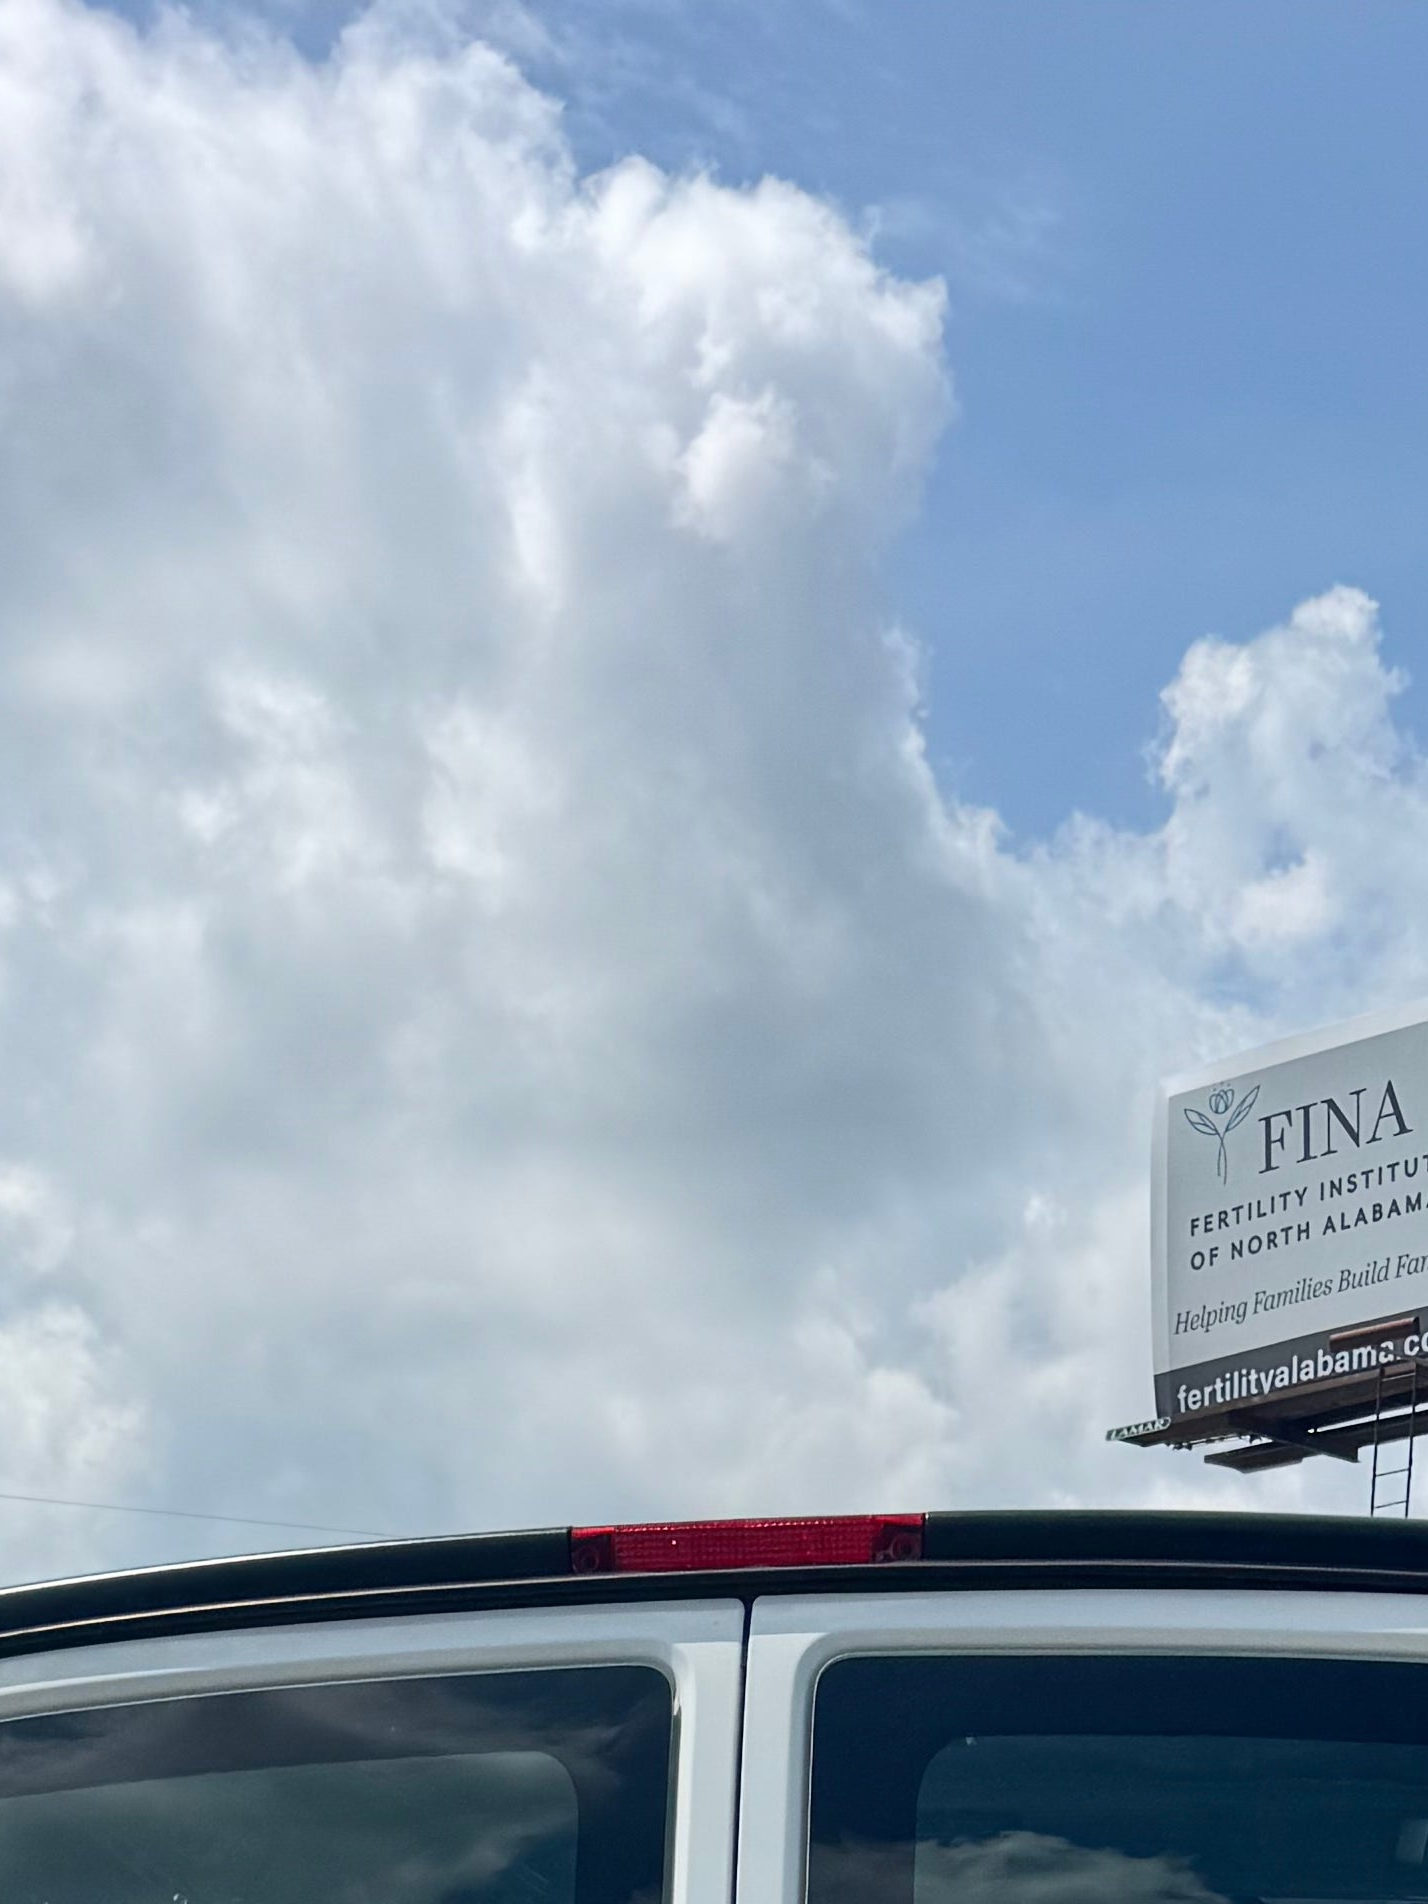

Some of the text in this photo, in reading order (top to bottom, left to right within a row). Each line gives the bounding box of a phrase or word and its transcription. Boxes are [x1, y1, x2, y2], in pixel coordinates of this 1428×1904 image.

[1258, 1080, 1413, 1174] FINA
[1190, 1186, 1308, 1236] FERTILITY
[1191, 1247, 1219, 1271] OF
[1231, 1222, 1310, 1260] NORTH
[1174, 1299, 1248, 1335] Helping
[1252, 1277, 1333, 1315] Families
[1338, 1257, 1390, 1292] Build
[1111, 1418, 1165, 1440] LAMAR
